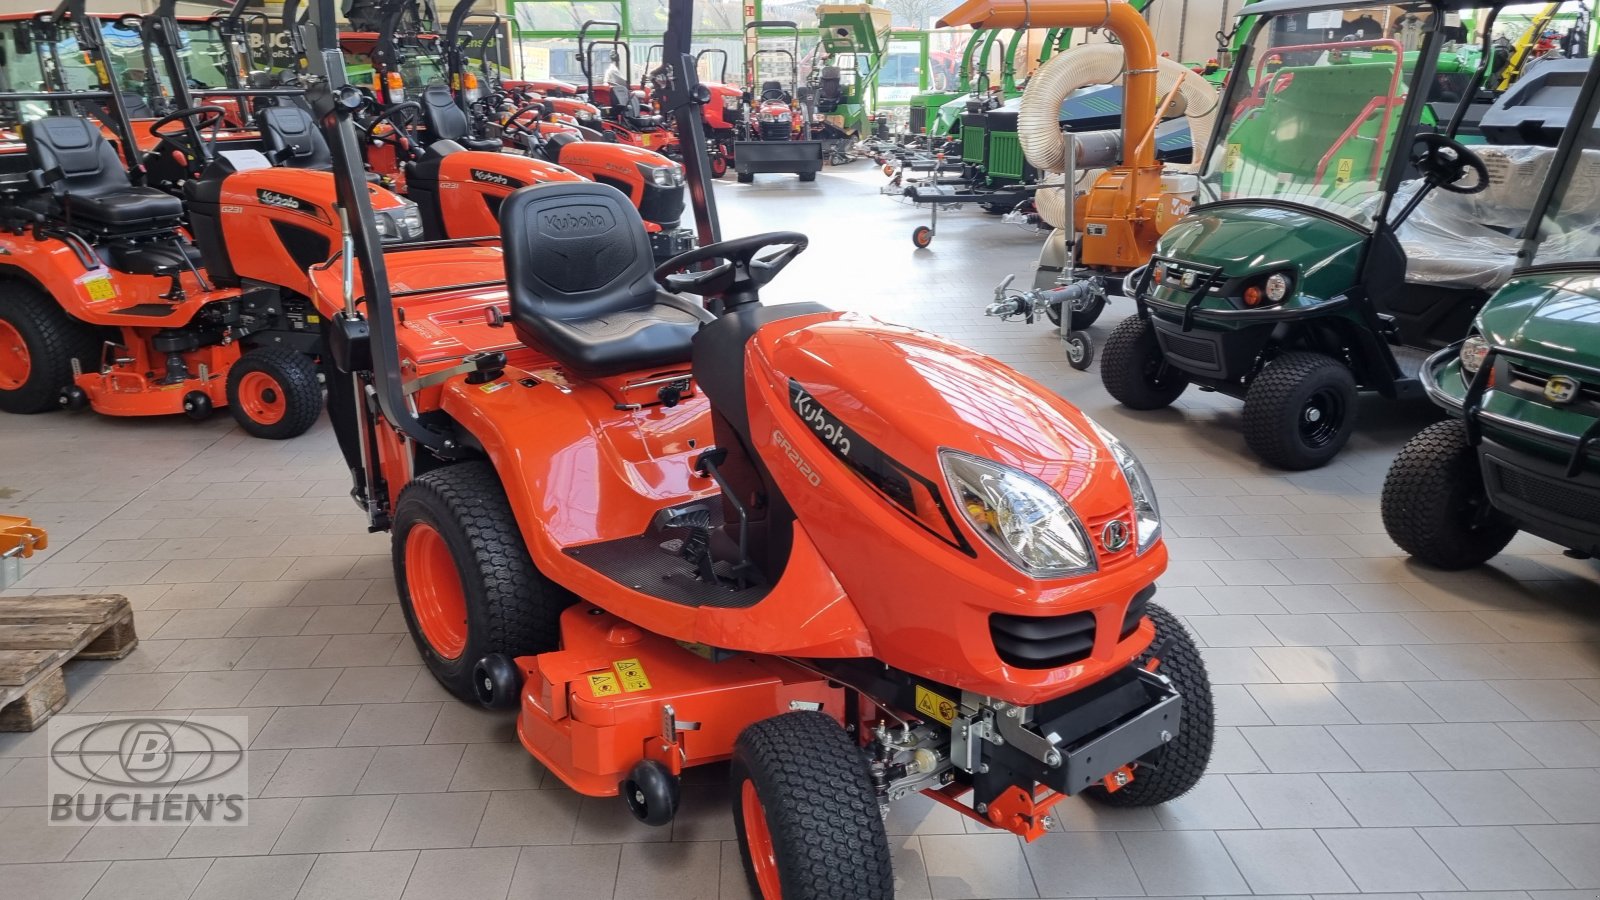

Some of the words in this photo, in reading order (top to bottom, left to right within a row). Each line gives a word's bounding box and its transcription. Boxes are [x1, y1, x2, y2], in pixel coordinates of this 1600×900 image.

[475, 171, 507, 184] Kubota
[262, 191, 299, 209] Kubota
[221, 206, 243, 214] G231
[544, 212, 605, 231] Kubota
[795, 390, 851, 456] Kubota
[773, 429, 821, 487] GR2120
